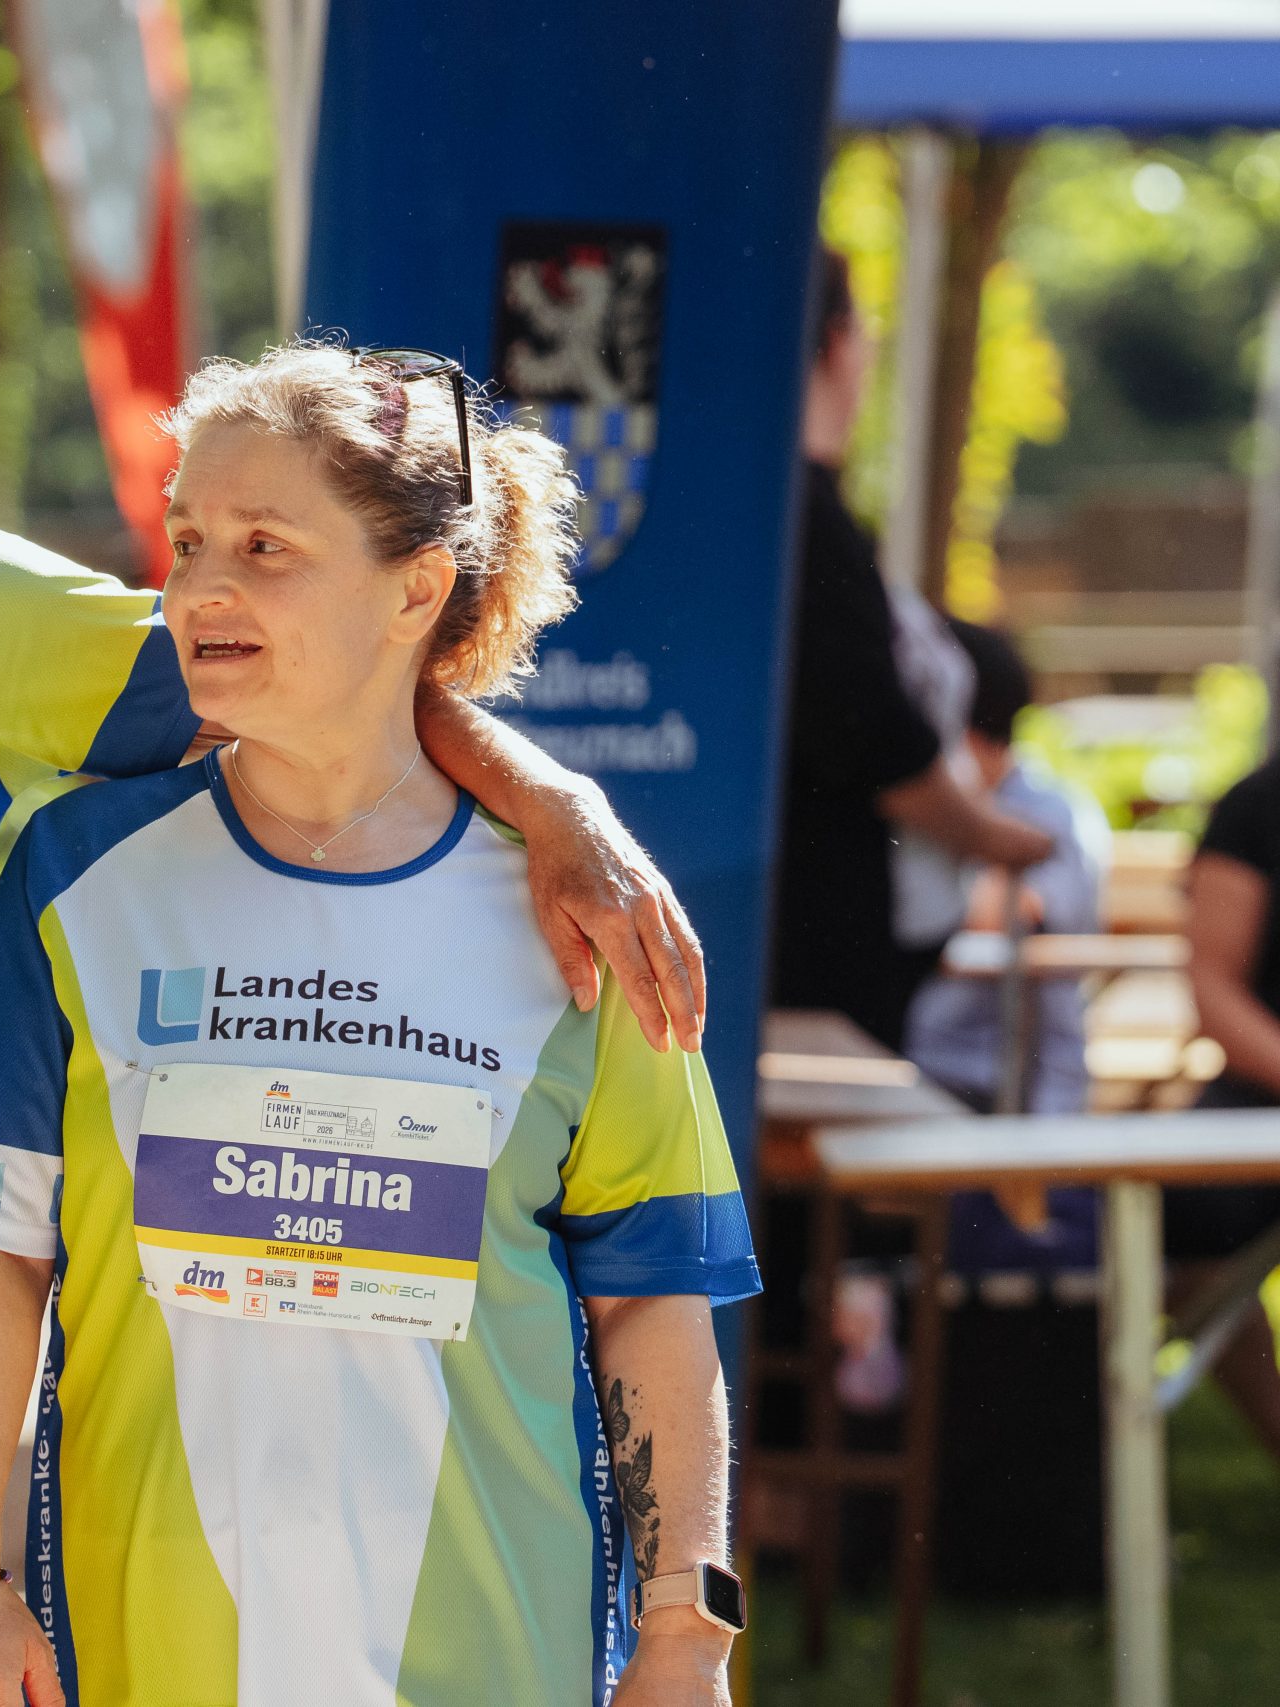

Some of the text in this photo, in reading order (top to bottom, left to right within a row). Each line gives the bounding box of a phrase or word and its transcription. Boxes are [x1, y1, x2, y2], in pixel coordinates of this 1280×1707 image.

[214, 966, 380, 1003] Landes
[209, 1006, 502, 1072] krankenhaus
[270, 1081, 289, 1093] dm
[267, 1103, 302, 1115] FIRMEN
[265, 1115, 302, 1130] LAUF
[317, 1126, 333, 1135] 2026
[212, 1146, 412, 1212] Sabrina
[273, 1214, 343, 1245] 3405
[266, 1246, 343, 1262] STARTZEIT 18:15 UHR
[183, 1260, 225, 1289] dm
[264, 1277, 296, 1288] 88.3
[314, 1273, 339, 1281] SCHUH
[350, 1280, 436, 1300] BIONTECH
